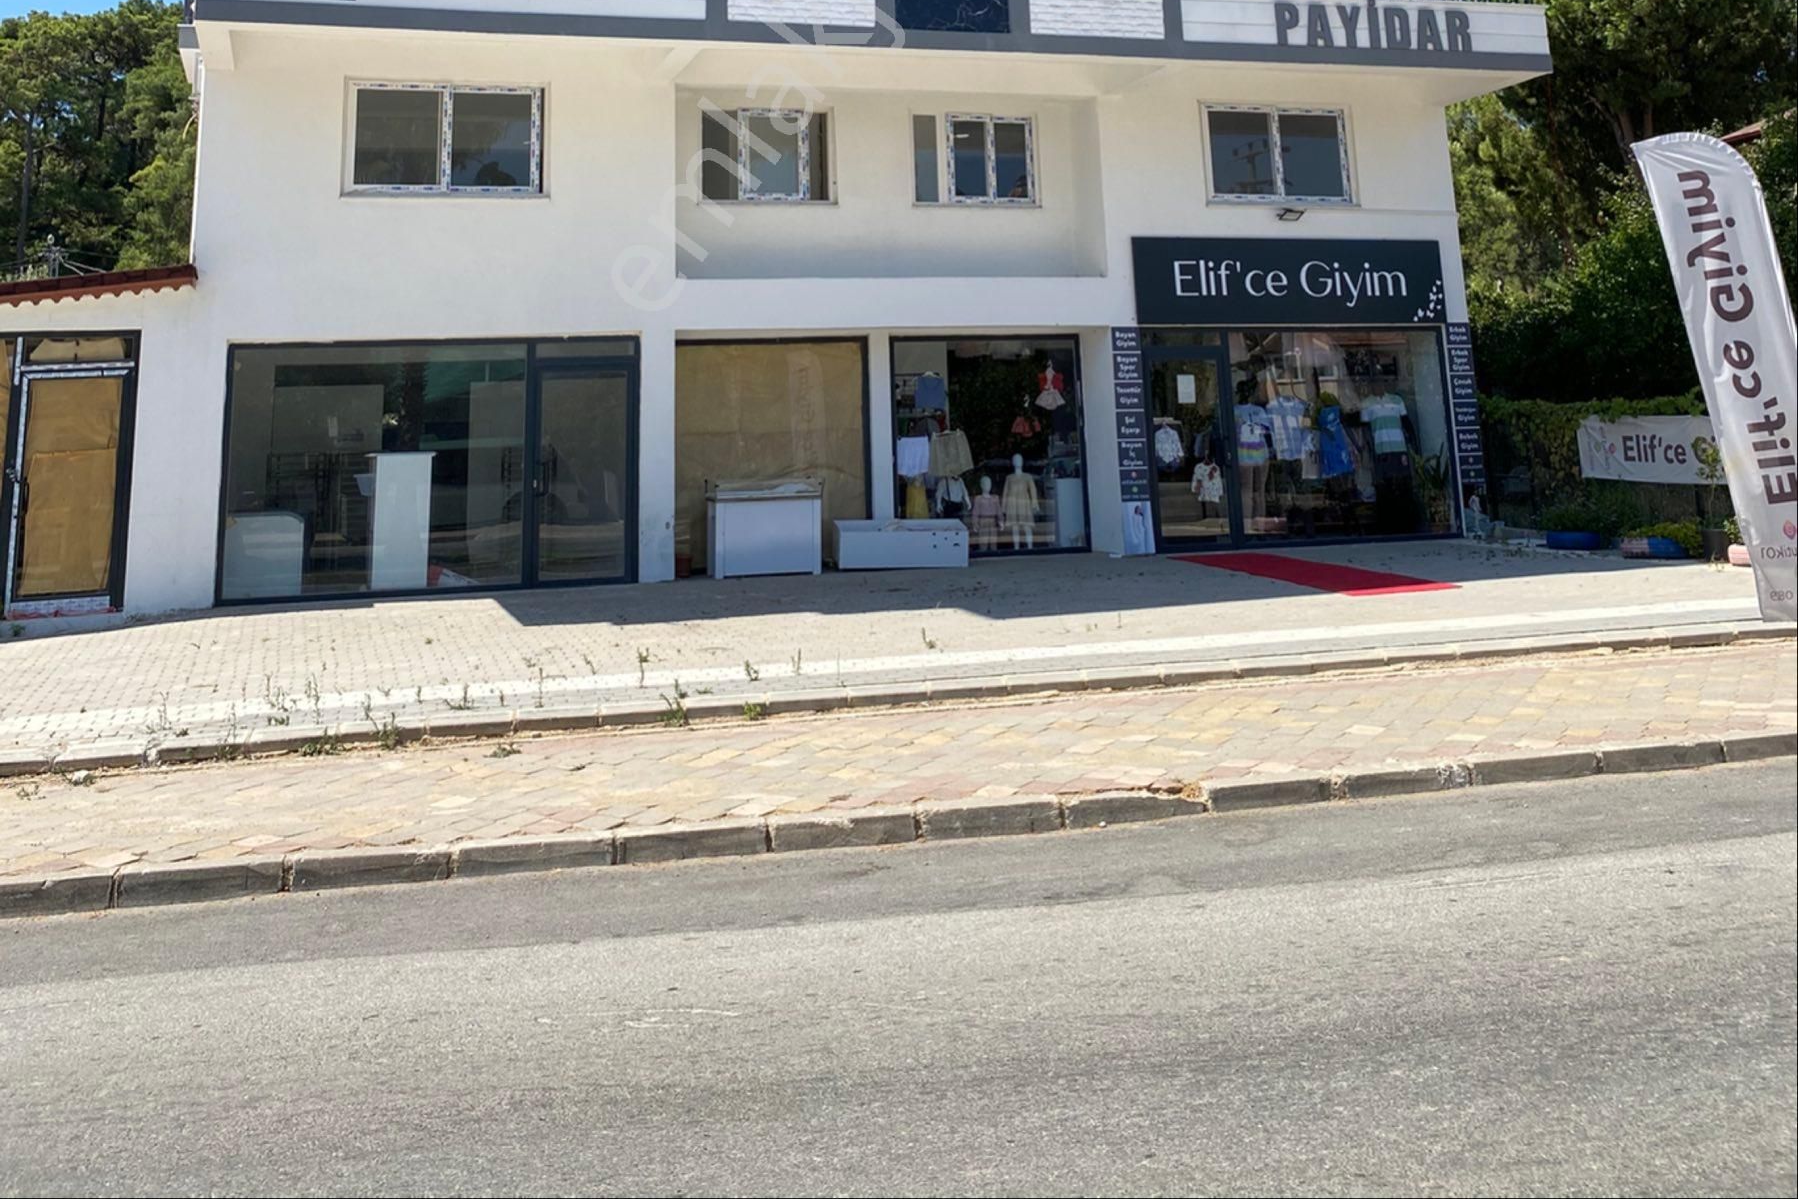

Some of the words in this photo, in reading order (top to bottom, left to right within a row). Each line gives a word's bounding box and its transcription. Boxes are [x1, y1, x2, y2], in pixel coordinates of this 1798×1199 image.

[1172, 259, 1288, 298] Elif'ce
[1299, 260, 1408, 308] Giyim
[1449, 333, 1468, 342] Giyim
[1115, 339, 1137, 348] Giyim
[1452, 364, 1471, 372] Giyim
[1118, 371, 1138, 380] Giyim
[1454, 387, 1473, 396] Giyim
[1119, 396, 1139, 405] Giyim
[1457, 414, 1476, 422] Giyim
[1621, 434, 1687, 465] Elif'ce
